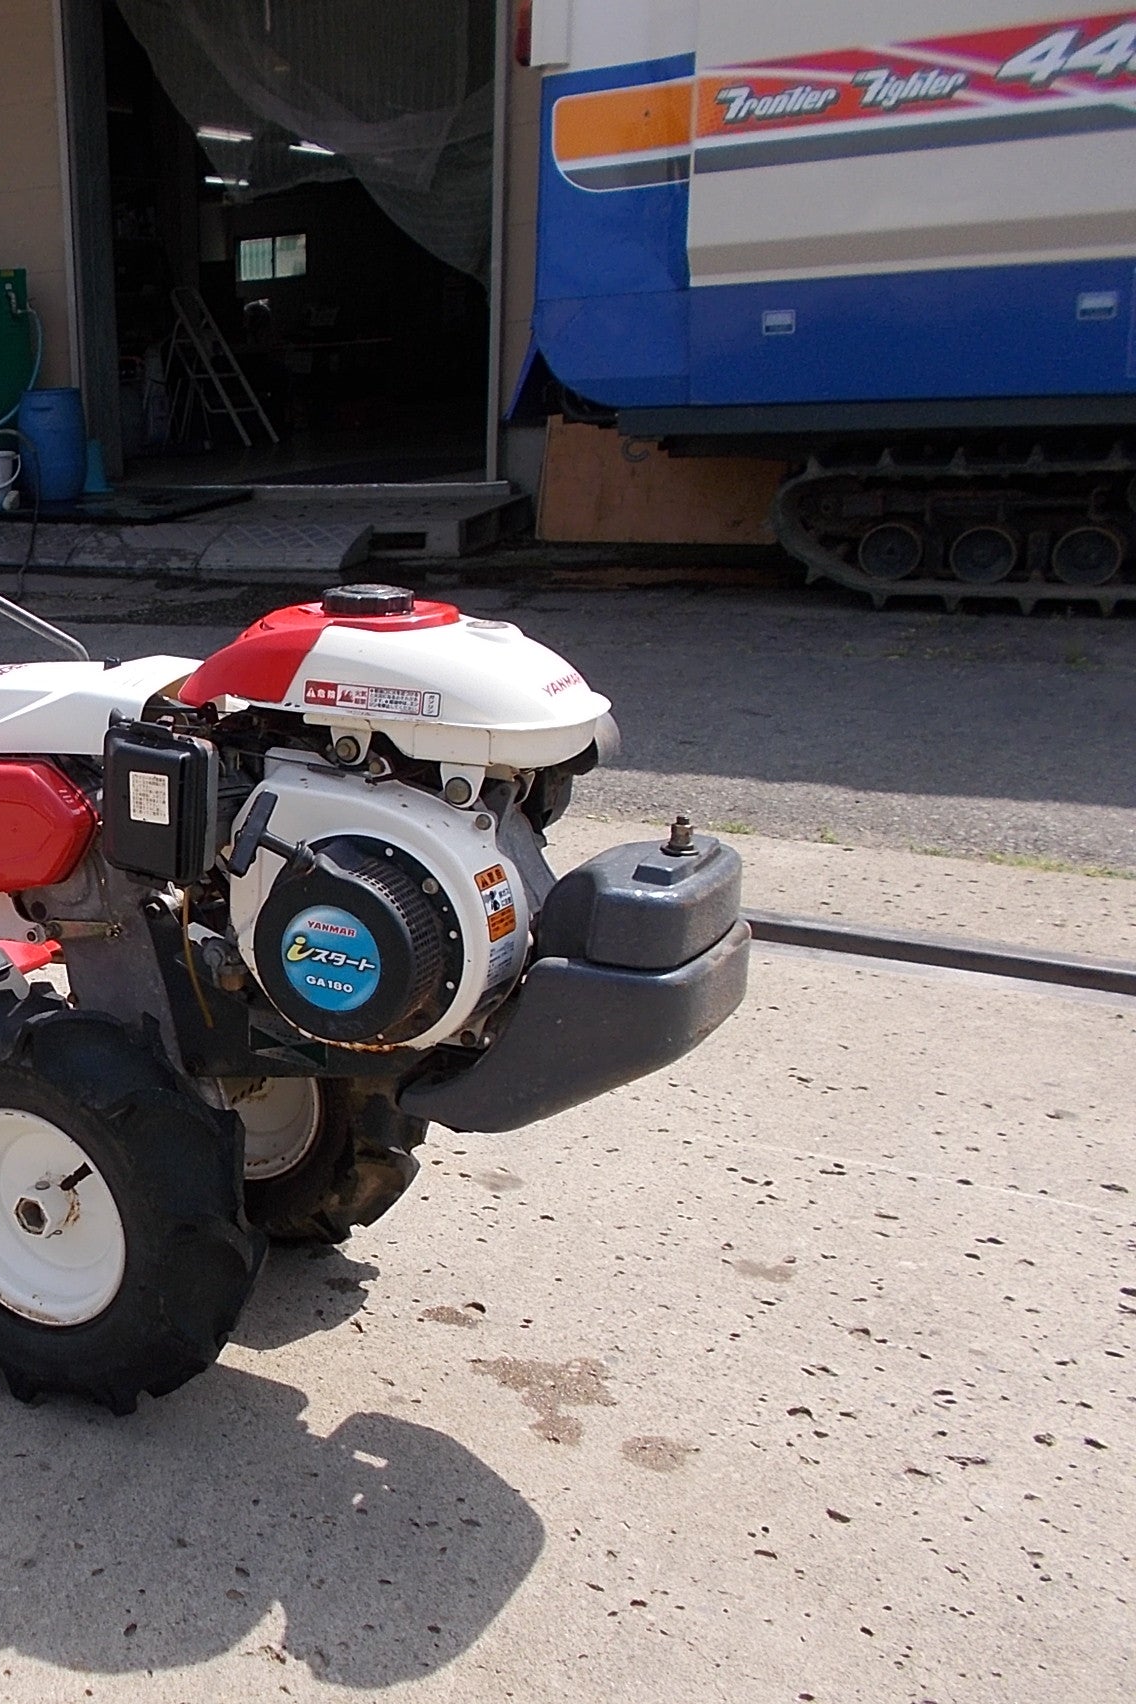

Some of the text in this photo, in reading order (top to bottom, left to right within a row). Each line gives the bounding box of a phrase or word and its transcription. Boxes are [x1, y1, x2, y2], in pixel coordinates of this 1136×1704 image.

[716, 22, 1136, 124] Frontier Fighter 44
[317, 688, 336, 699] 危険
[542, 672, 582, 697] YANMAR
[307, 920, 356, 938] YANMAR
[286, 936, 376, 971] iスタート
[305, 975, 354, 994] GA180
